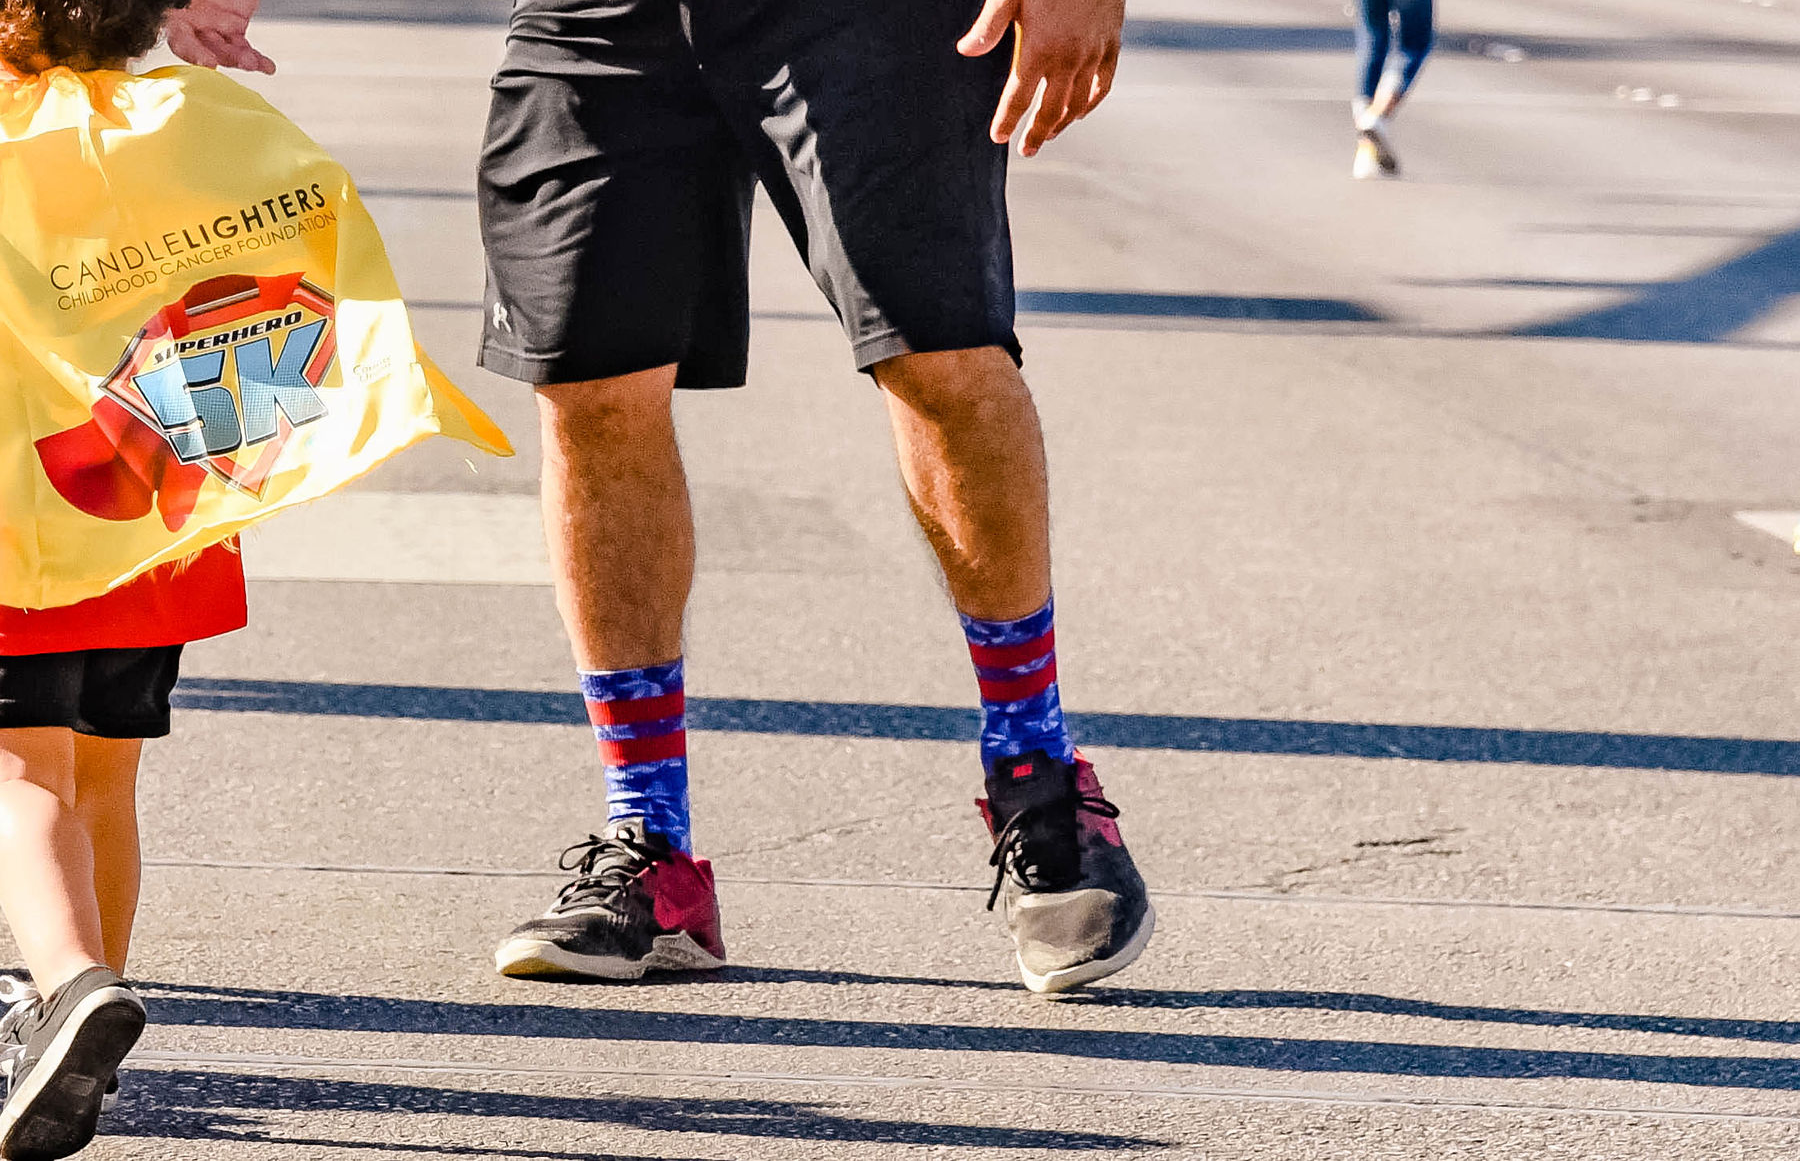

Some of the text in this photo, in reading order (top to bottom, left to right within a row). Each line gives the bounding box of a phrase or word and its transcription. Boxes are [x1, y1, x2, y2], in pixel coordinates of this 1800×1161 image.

[50, 183, 326, 291] CANDLELIGHTERS
[57, 210, 337, 310] CHILDHOOD CANCER FOUNDATION
[153, 311, 302, 365] SUPERHERO
[132, 317, 329, 464] 5K
